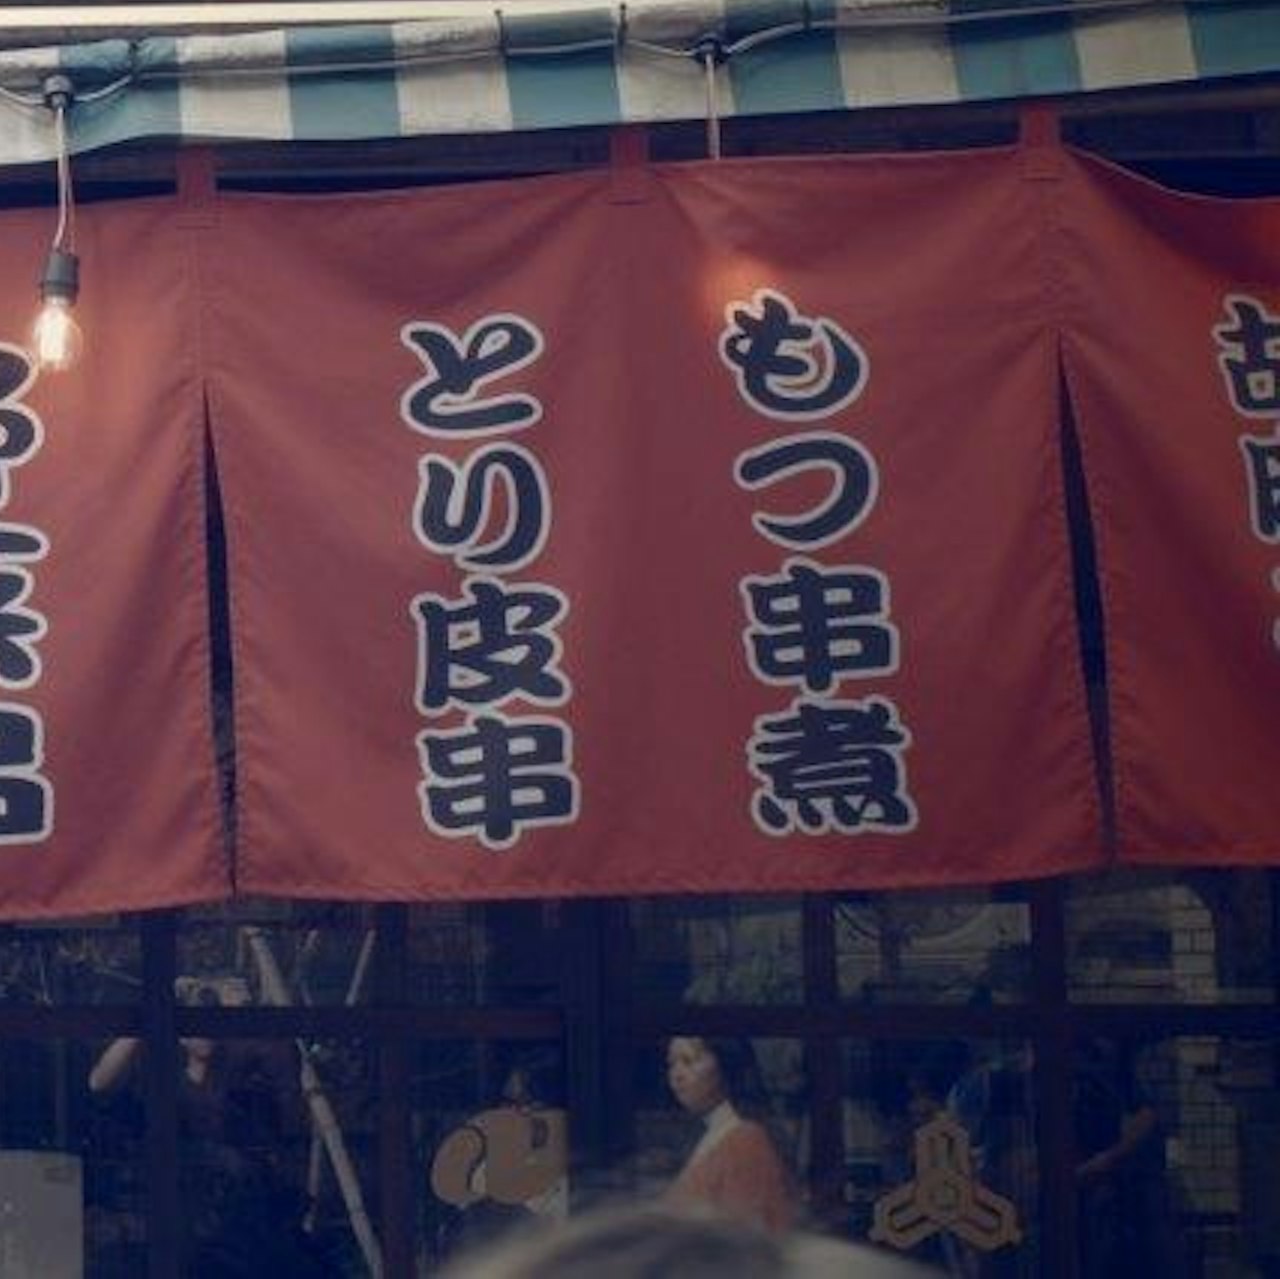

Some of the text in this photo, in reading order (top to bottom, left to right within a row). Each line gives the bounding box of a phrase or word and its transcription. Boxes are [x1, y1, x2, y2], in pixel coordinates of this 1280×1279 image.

[401, 314, 582, 849] とり皮串
[721, 289, 918, 835] もつ串煮
